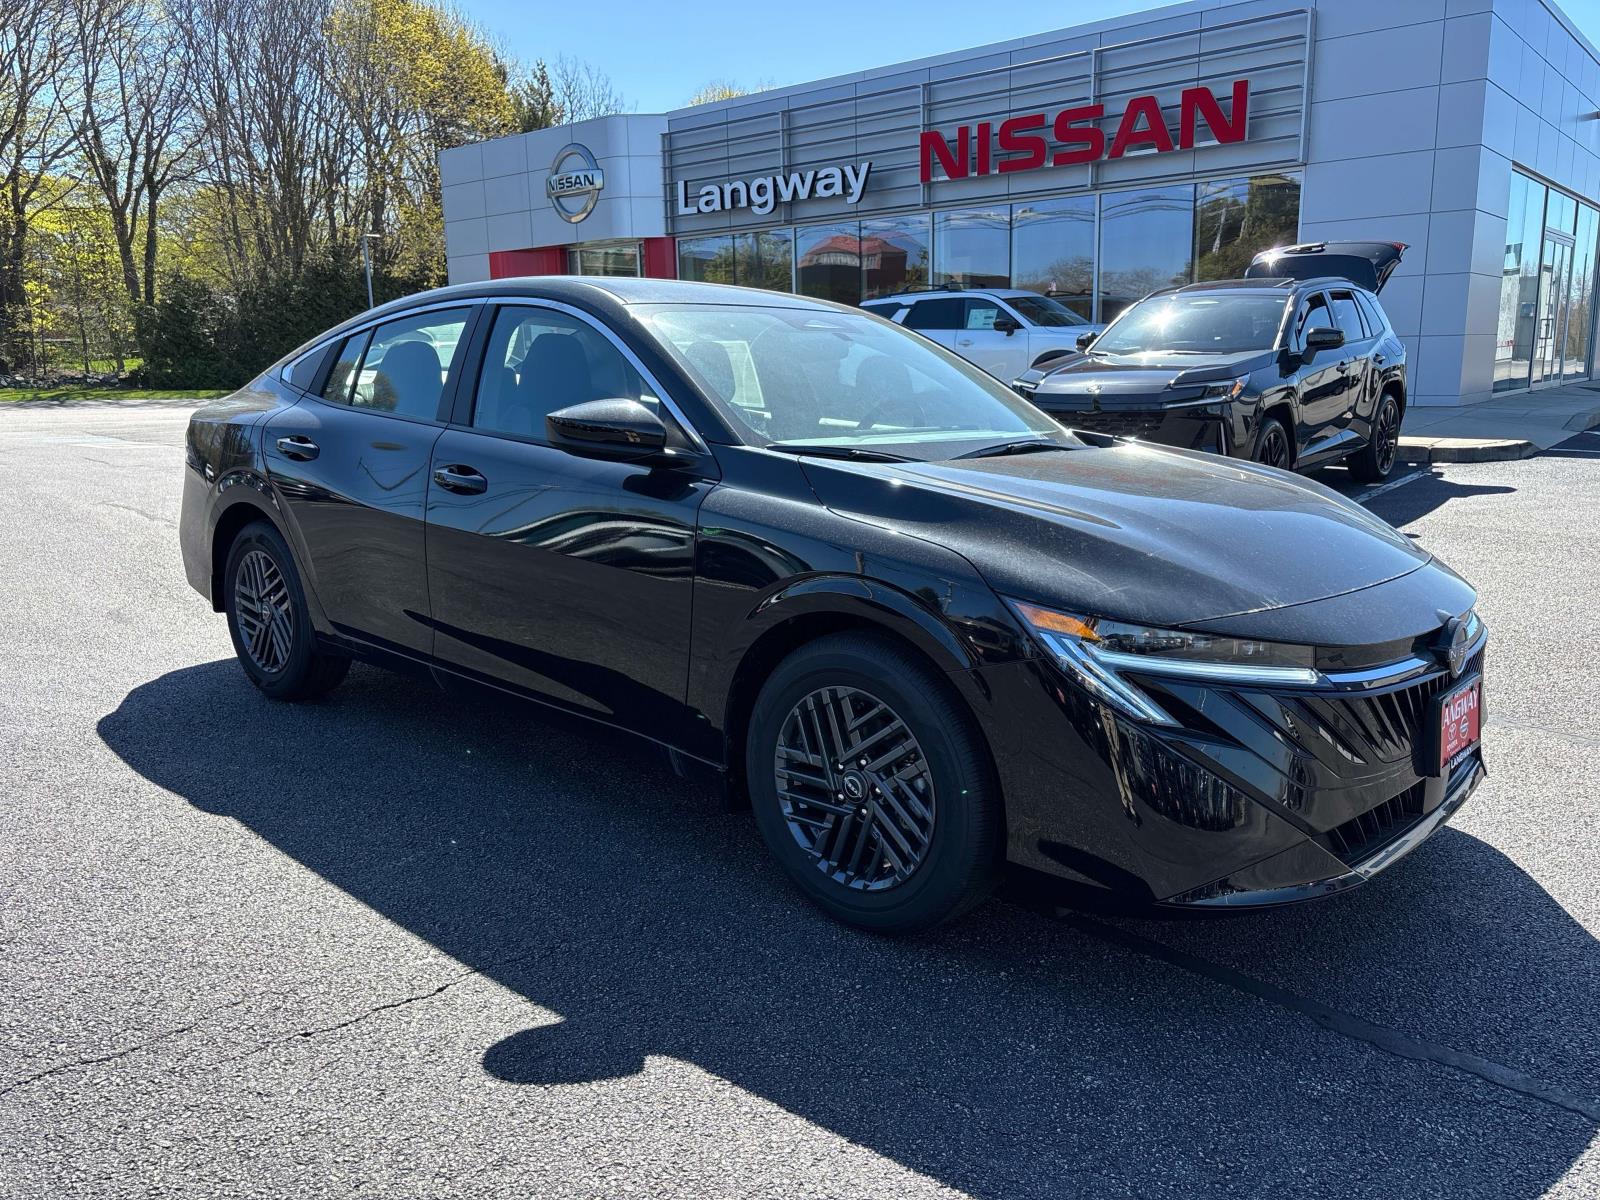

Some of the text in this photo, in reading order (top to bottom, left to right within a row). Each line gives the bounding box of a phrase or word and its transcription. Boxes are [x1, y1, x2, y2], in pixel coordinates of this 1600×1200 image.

[919, 79, 1250, 184] NISSAN
[548, 173, 595, 192] NISSAN
[677, 162, 872, 215] Langway
